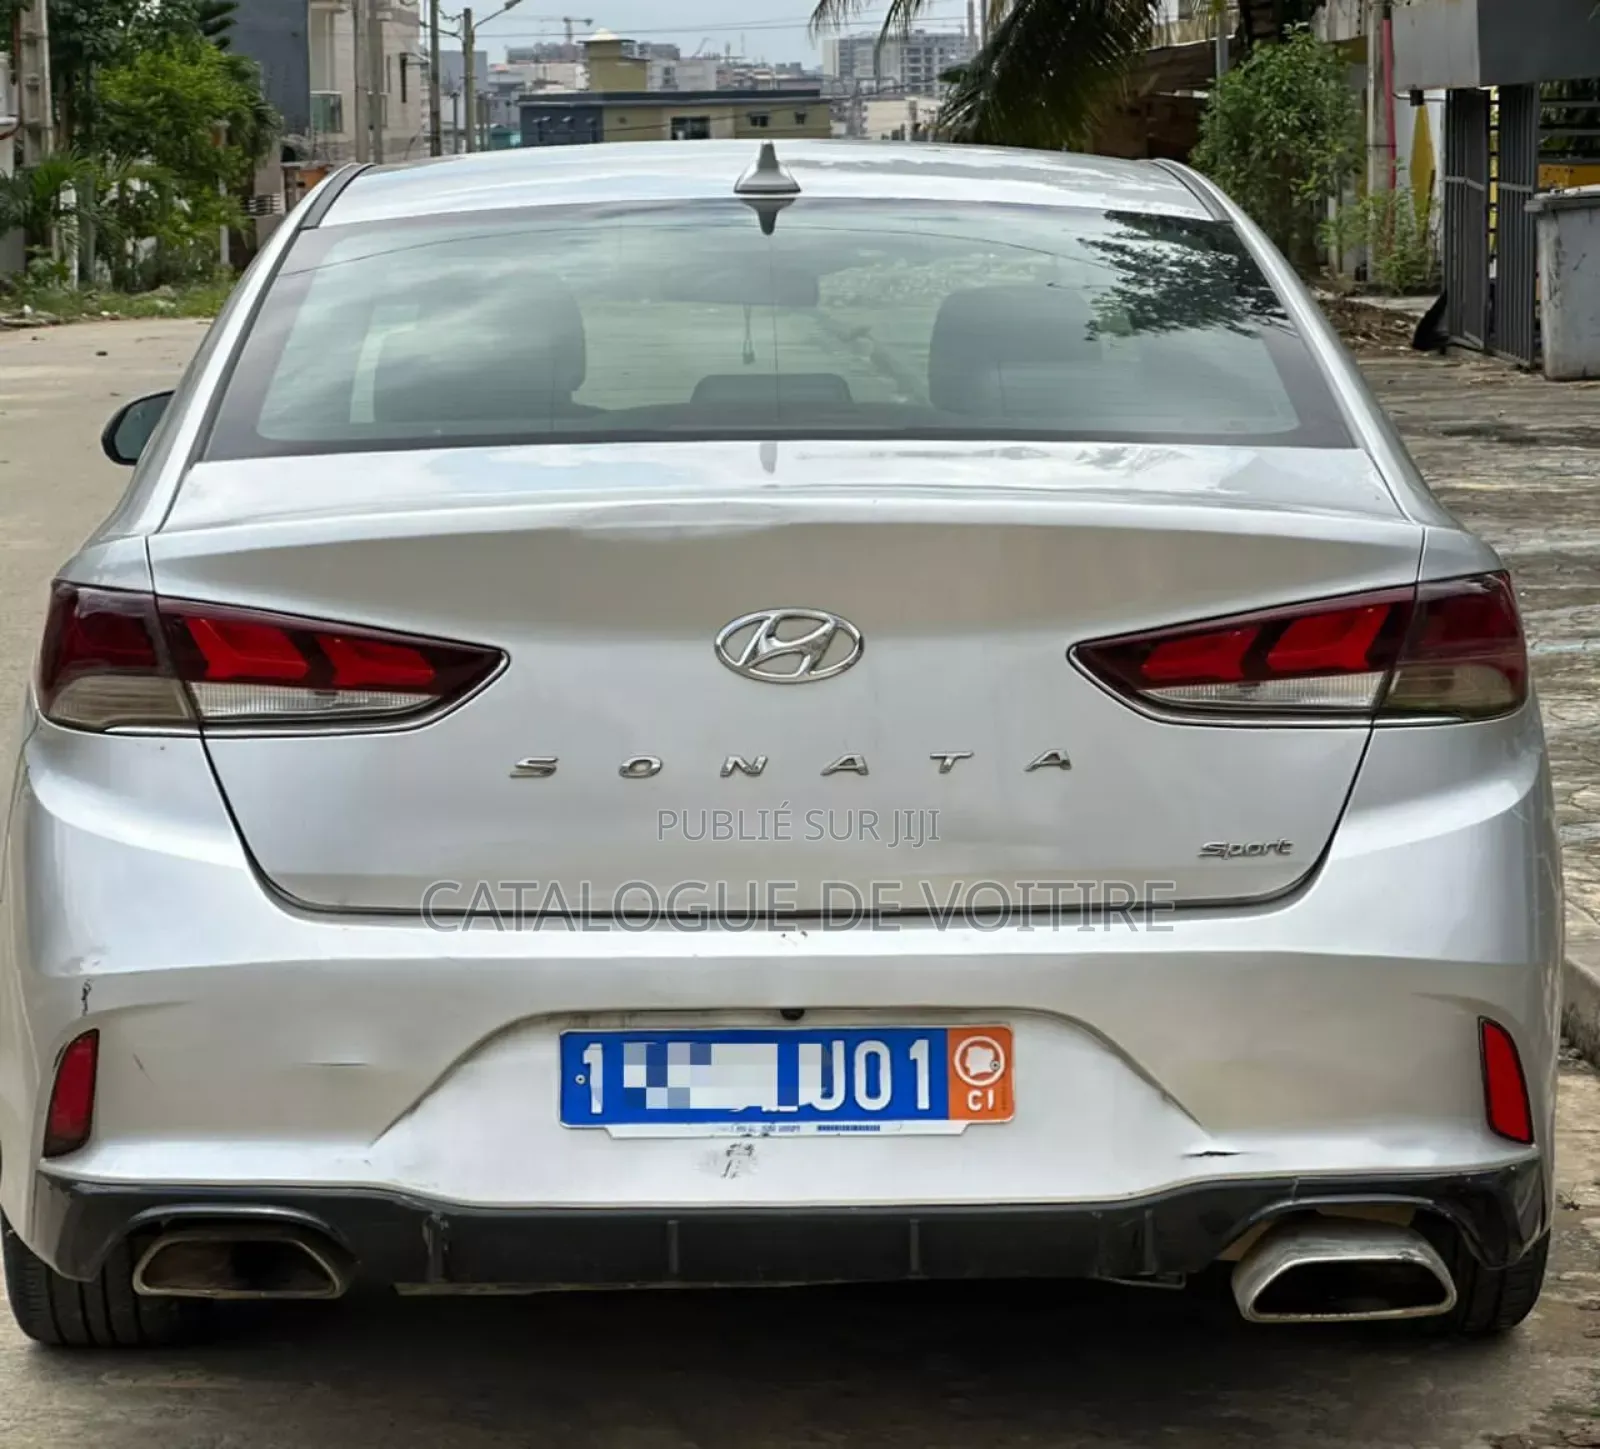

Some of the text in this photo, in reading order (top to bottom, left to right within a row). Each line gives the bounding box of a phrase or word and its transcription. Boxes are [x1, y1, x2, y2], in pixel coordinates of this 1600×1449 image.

[509, 749, 1072, 779] SONATA
[1198, 838, 1295, 860] Sport
[967, 1089, 995, 1111] CI
